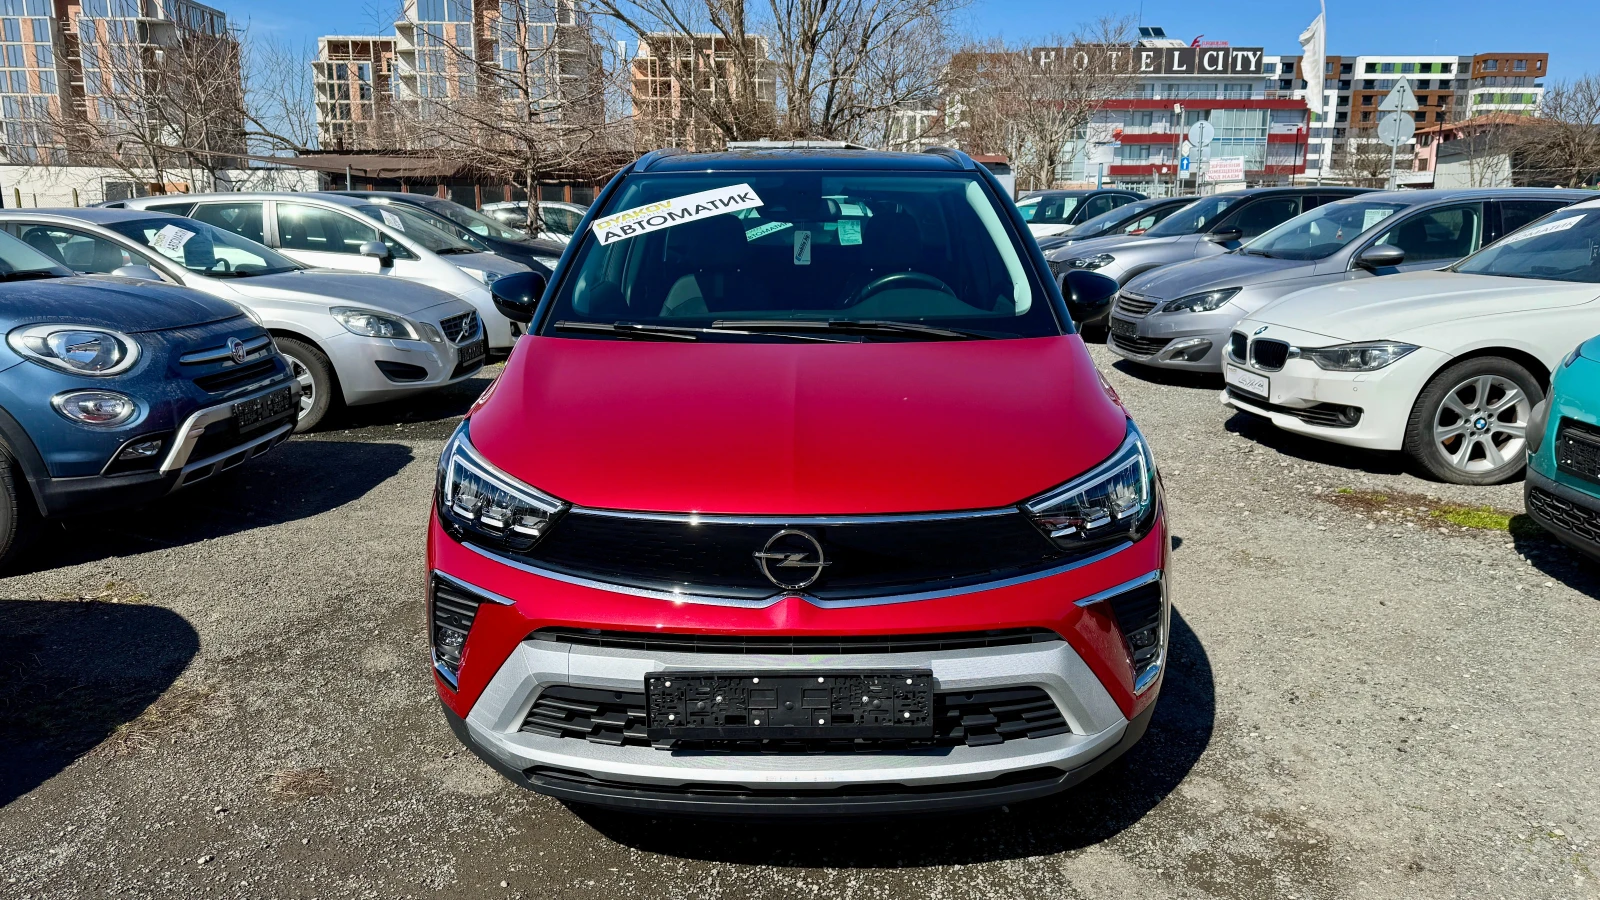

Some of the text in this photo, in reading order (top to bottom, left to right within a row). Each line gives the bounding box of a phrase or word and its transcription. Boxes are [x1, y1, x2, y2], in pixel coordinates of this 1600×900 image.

[1040, 51, 1264, 71] HOTEL CITY
[596, 200, 672, 230] DYAKOV
[603, 192, 755, 243] АВТОМАТИК
